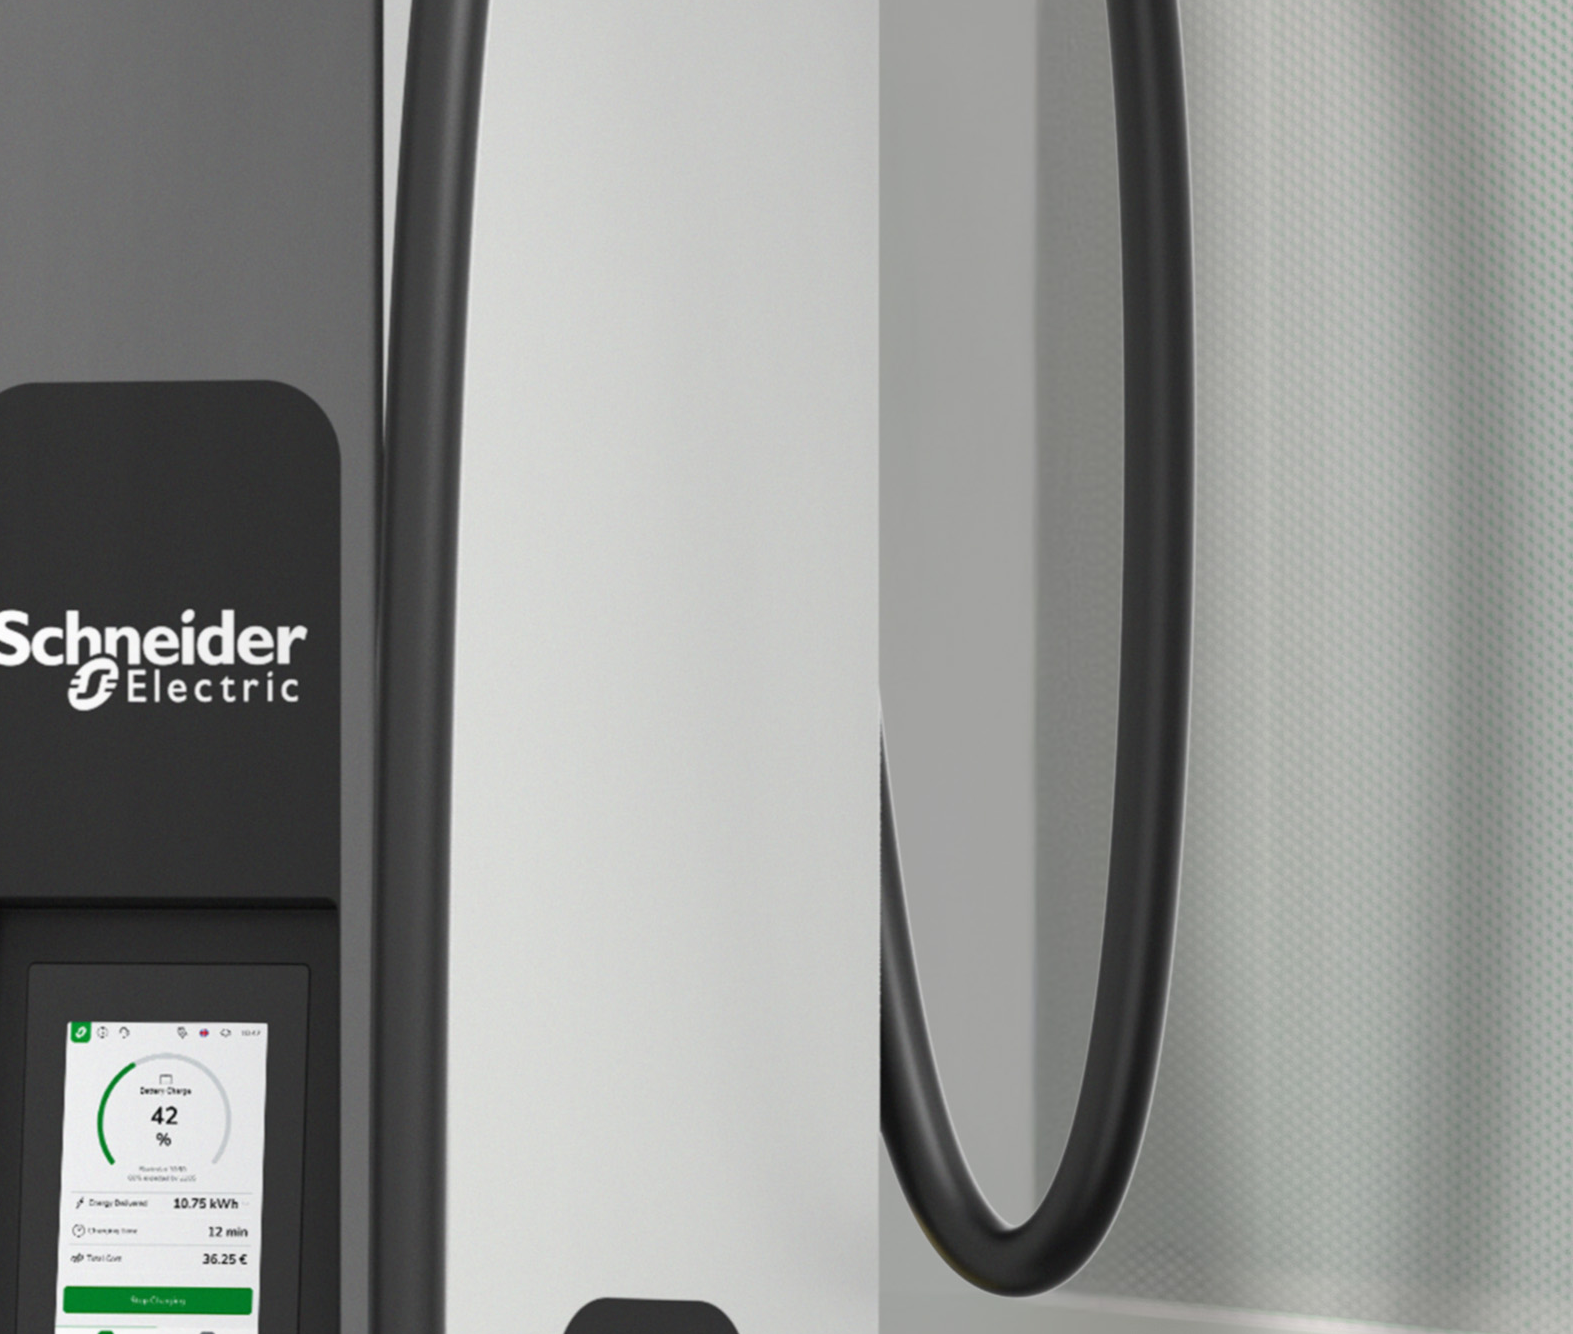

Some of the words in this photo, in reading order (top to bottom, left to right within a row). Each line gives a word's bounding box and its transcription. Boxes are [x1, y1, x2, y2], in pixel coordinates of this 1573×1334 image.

[127, 669, 299, 703] Electric
[151, 1106, 178, 1125] 42
[155, 1132, 172, 1147] %
[173, 1198, 207, 1209] 10.75
[210, 1198, 239, 1209] kWh
[208, 1226, 223, 1238] 12
[226, 1226, 249, 1238] min
[202, 1253, 237, 1265] 36.25
[239, 1253, 248, 1265] €
